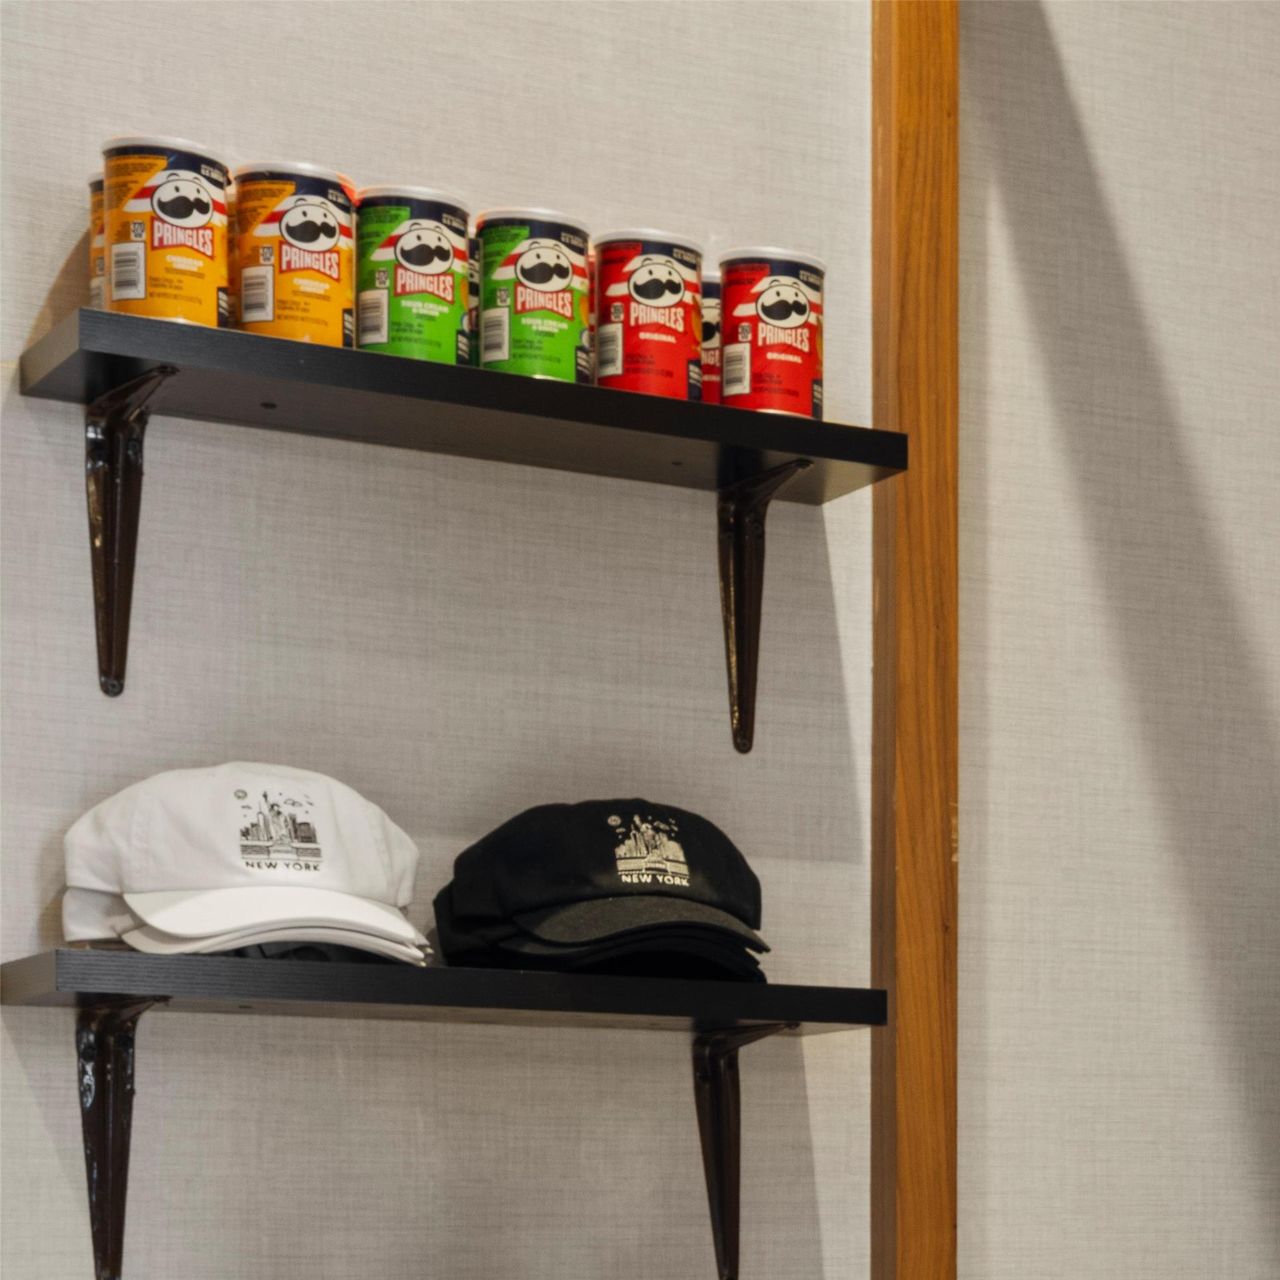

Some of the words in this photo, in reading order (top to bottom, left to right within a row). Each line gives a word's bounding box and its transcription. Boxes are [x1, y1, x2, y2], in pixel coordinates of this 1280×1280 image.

[153, 219, 214, 258] PRINGLES
[281, 244, 339, 280] PRINGLES
[396, 269, 453, 304] PRINGLES
[517, 285, 573, 320] PRINGLES
[630, 302, 684, 333] PRINGLES
[758, 323, 809, 352] PRINGLES
[284, 862, 319, 871] YORK
[621, 875, 652, 883] NEW
[656, 875, 690, 886] YORK
